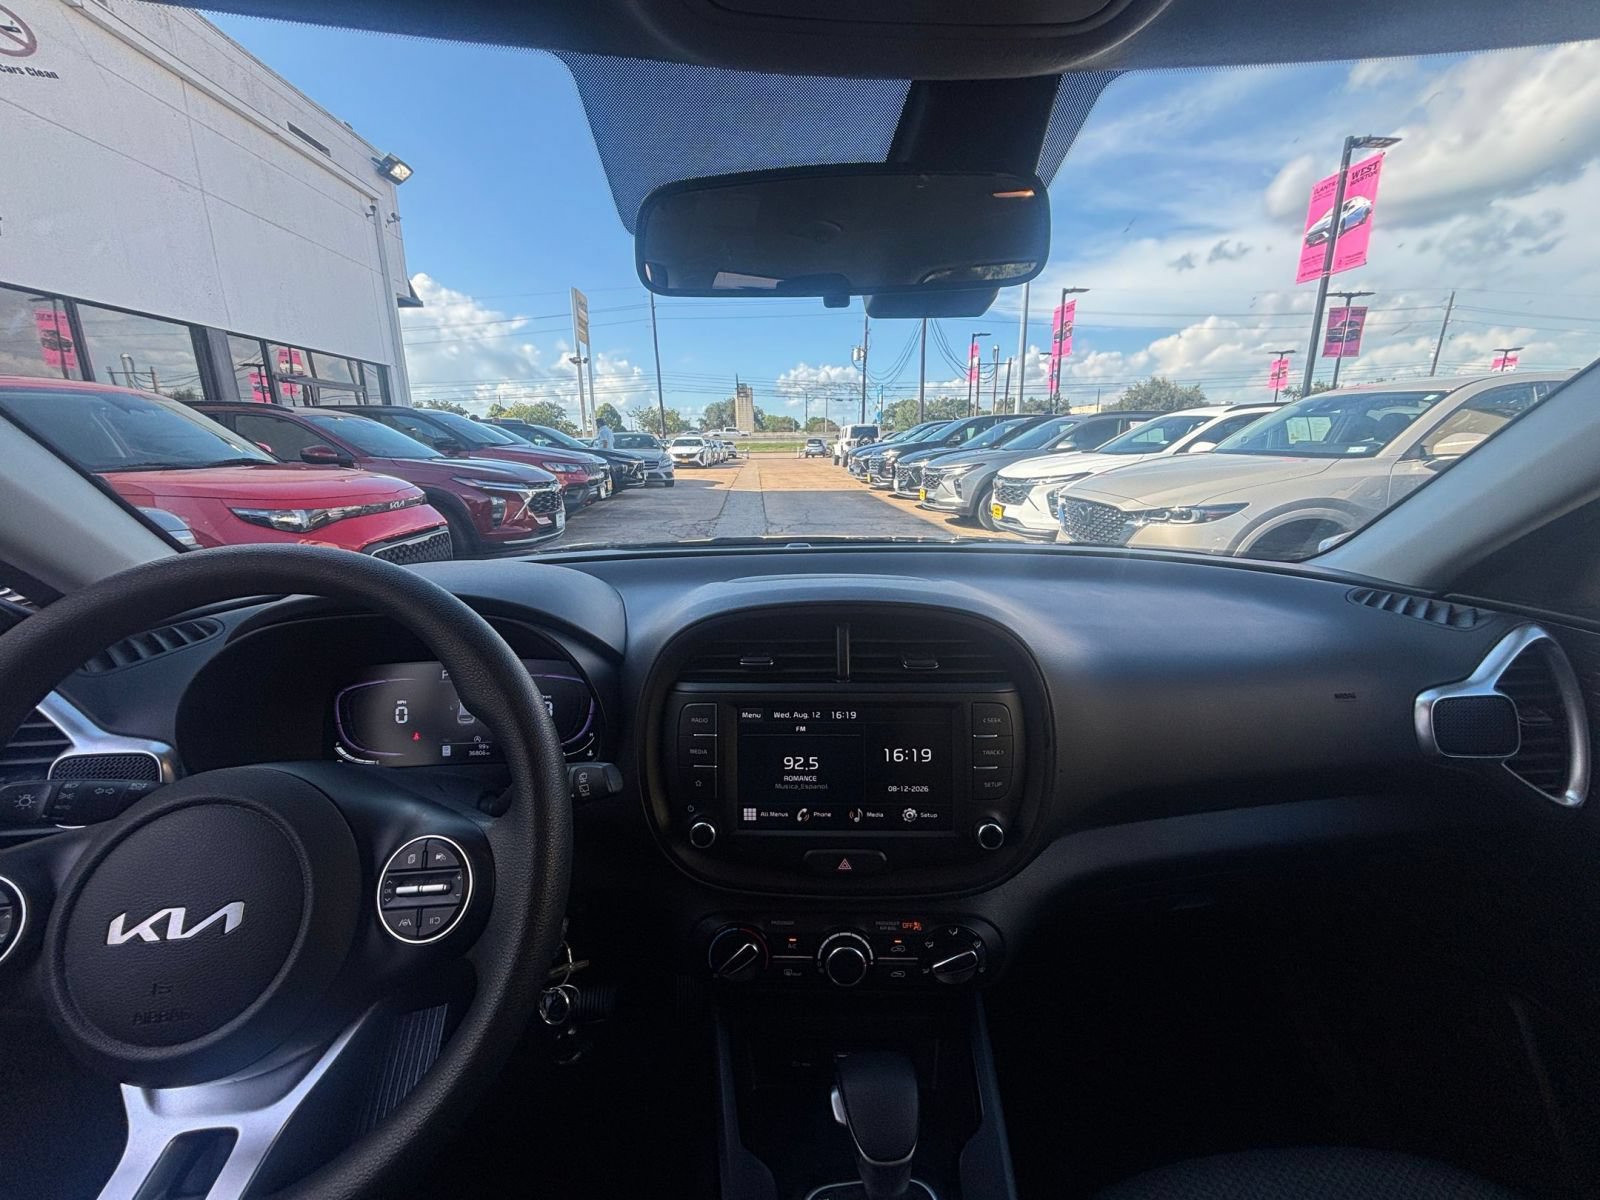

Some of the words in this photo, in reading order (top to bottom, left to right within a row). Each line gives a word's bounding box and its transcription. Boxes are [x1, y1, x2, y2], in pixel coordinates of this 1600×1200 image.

[25, 66, 59, 79] Clean
[1351, 160, 1380, 181] WEST
[395, 706, 408, 724] 0
[741, 711, 762, 719] Menu
[773, 711, 792, 719] Wed.
[793, 711, 810, 720] Aug.
[812, 711, 821, 719] 12
[831, 710, 857, 720] 16:19
[690, 716, 709, 725] RADIO
[689, 747, 708, 756] MEDIA
[883, 747, 932, 763] 16:19
[783, 755, 819, 771] 92.5
[887, 785, 929, 793] 08-12-2026
[984, 781, 1003, 789] SETUP
[866, 811, 884, 819] Media
[920, 811, 938, 820] Setup
[106, 900, 246, 945] KIA
[902, 921, 914, 929] OFF
